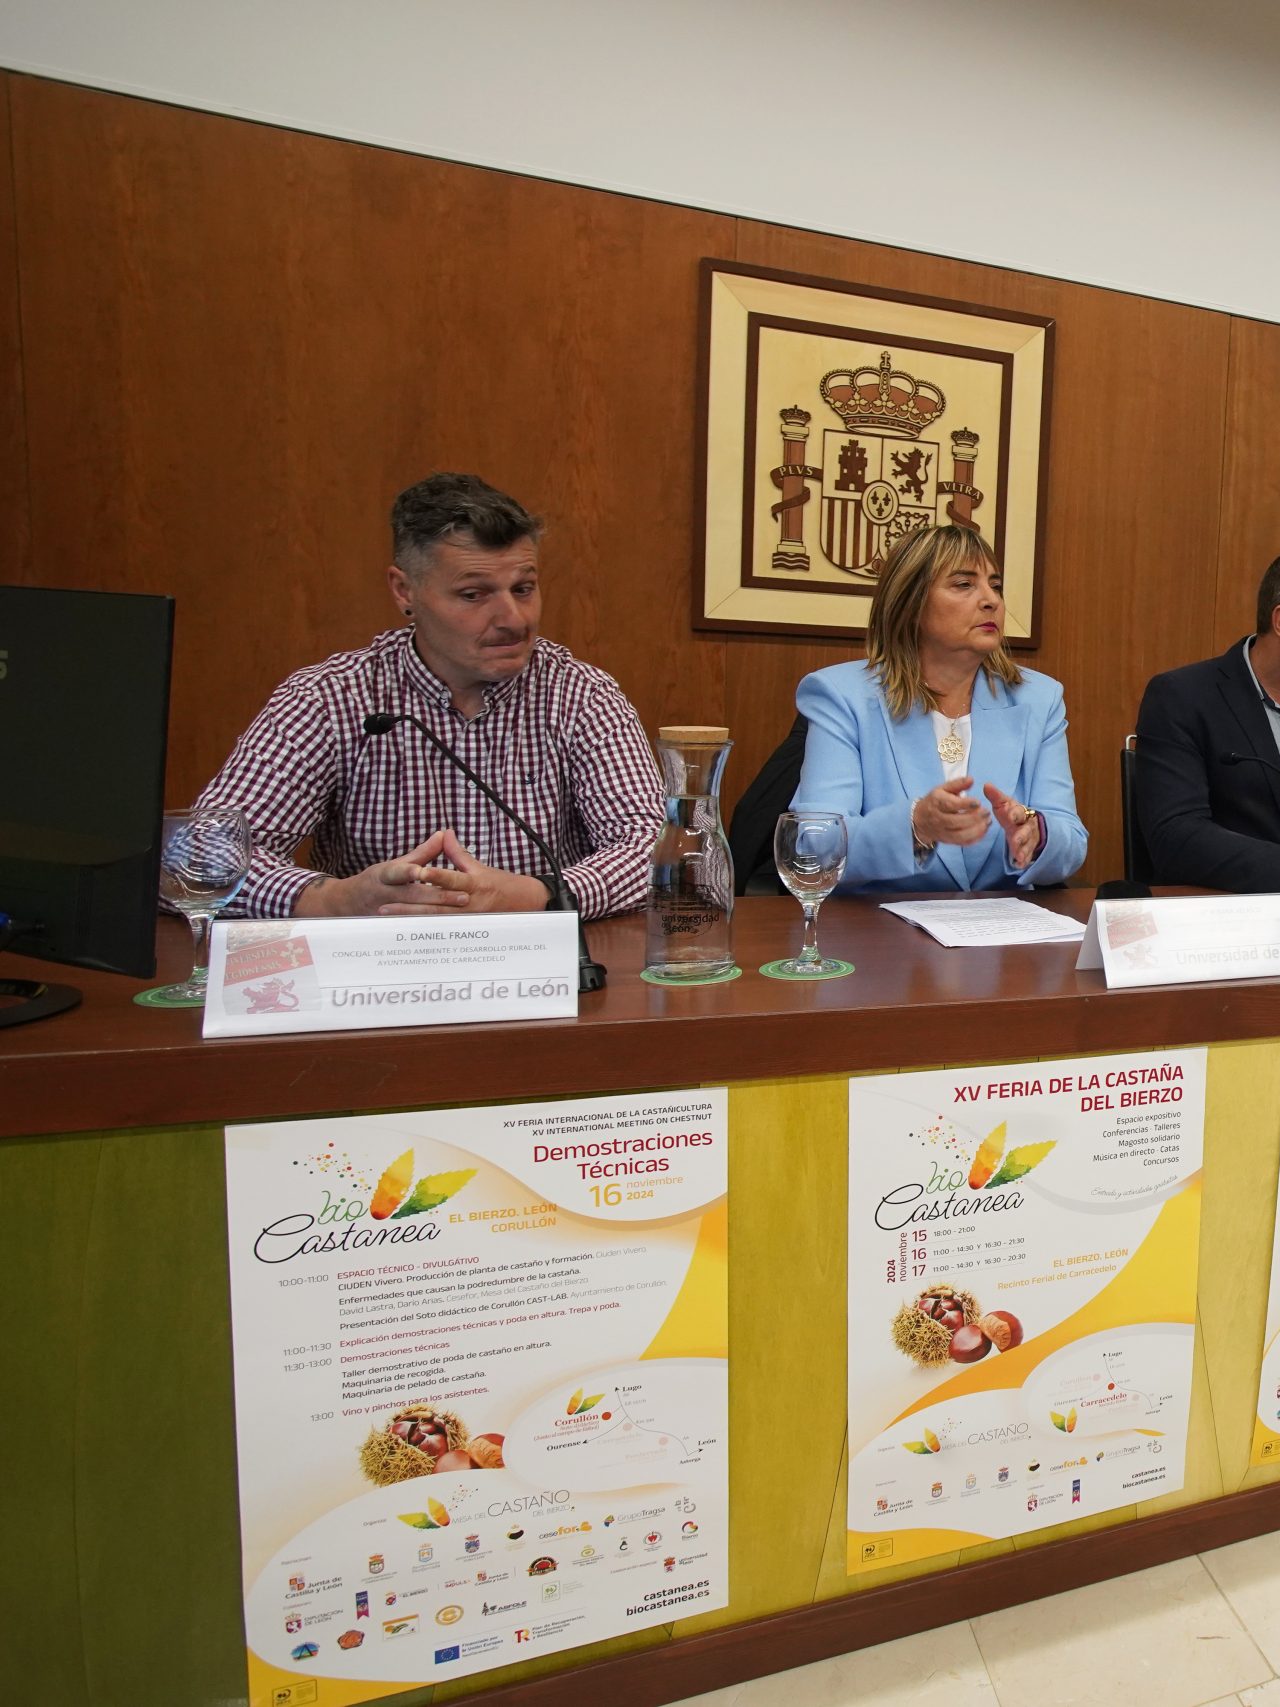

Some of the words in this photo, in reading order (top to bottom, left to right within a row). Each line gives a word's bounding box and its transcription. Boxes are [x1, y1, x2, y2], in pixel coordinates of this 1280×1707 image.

[778, 464, 814, 478] PLVS
[942, 481, 981, 500] VLTRA
[396, 933, 406, 941] D.
[410, 932, 446, 940] DANIEL
[449, 930, 489, 939] FRANCO
[451, 955, 505, 963] CARRACEDELO
[1176, 947, 1258, 965] Universidad
[1264, 946, 1280, 959] de
[331, 981, 472, 1006] Universidad
[480, 978, 509, 999] de
[516, 976, 568, 997] León
[954, 1085, 981, 1102] XV
[987, 1080, 1042, 1098] FERIA
[1049, 1077, 1072, 1093] DE
[1078, 1074, 1100, 1090] LA
[1105, 1064, 1183, 1087] CASTAÑA
[1081, 1095, 1114, 1111] DEL
[1120, 1087, 1182, 1107] BIERZO
[517, 1118, 543, 1126] FERIA
[545, 1113, 613, 1124] INTERNACIONAL
[616, 1110, 627, 1118] DE
[642, 1103, 712, 1115] CASTAÑICULTURA
[546, 1123, 614, 1134] INTERNATIONAL
[616, 1118, 654, 1127] MEETING
[670, 1113, 711, 1122] CHESTNUT
[1116, 1116, 1143, 1124] Espacio
[1145, 1111, 1181, 1121] expositivo
[1102, 1126, 1148, 1137] Conferencias
[1153, 1122, 1180, 1130] Talleres
[533, 1133, 712, 1161] Demostraciones
[1118, 1138, 1148, 1147] Magosto
[1150, 1134, 1180, 1143] solidario
[1092, 1153, 1117, 1161] Música
[1129, 1148, 1155, 1156] directo
[1143, 1156, 1179, 1166] Concursos
[576, 1158, 669, 1178] Técnicas
[626, 1176, 684, 1189] noviembre
[924, 1161, 968, 1195] bio
[588, 1183, 622, 1208] 16
[626, 1189, 654, 1200] 2024
[318, 1190, 368, 1226] bio
[448, 1214, 464, 1223] EL
[468, 1208, 518, 1220] BIERZO.
[523, 1202, 559, 1215] LEÓN
[874, 1183, 1025, 1231] Castanea
[490, 1216, 558, 1232] CORULLÓN
[253, 1213, 441, 1264] Castanea
[912, 1229, 927, 1243] 15
[899, 1232, 908, 1282] noviembre
[911, 1247, 927, 1261] 16
[1053, 1259, 1064, 1267] EL
[1104, 1249, 1128, 1258] LEÓN
[337, 1268, 375, 1279] ESPACIO
[377, 1264, 414, 1274] TÉCNICO
[338, 1280, 372, 1290] CIUDEN
[374, 1278, 402, 1286] Vivero.
[406, 1271, 454, 1281] Producción
[468, 1266, 496, 1275] planta
[510, 1260, 543, 1269] castaño
[551, 1253, 594, 1263] formación.
[887, 1260, 896, 1284] 2024
[911, 1264, 926, 1277] 17
[278, 1274, 329, 1286] 10:00-11:00
[338, 1291, 404, 1305] Enfermedades
[406, 1289, 423, 1297] que
[425, 1285, 455, 1294] causan
[466, 1277, 524, 1289] podredumbre
[547, 1269, 581, 1278] castaña.
[339, 1335, 389, 1347] Explicación
[391, 1325, 461, 1339] demostraciones
[462, 1320, 497, 1329] técnicas
[505, 1316, 527, 1324] poda
[540, 1310, 566, 1318] altura.
[599, 1302, 620, 1311] poda.
[283, 1342, 331, 1355] 11:00-11:30
[340, 1348, 412, 1363] Demostraciones
[414, 1342, 450, 1351] técnicas
[283, 1358, 332, 1371] 11:30-13:00
[554, 1413, 599, 1427] Corullón
[546, 1440, 582, 1452] Ourense
[1122, 1474, 1166, 1489] biocastanea.es
[1131, 1466, 1166, 1479] castanea.es
[487, 1489, 571, 1519] CASTAÑO
[617, 1506, 666, 1522] GrupoTragsa
[538, 1525, 576, 1540] cesefor
[643, 1579, 710, 1602] castanea.es
[626, 1589, 710, 1617] biocastanea.es
